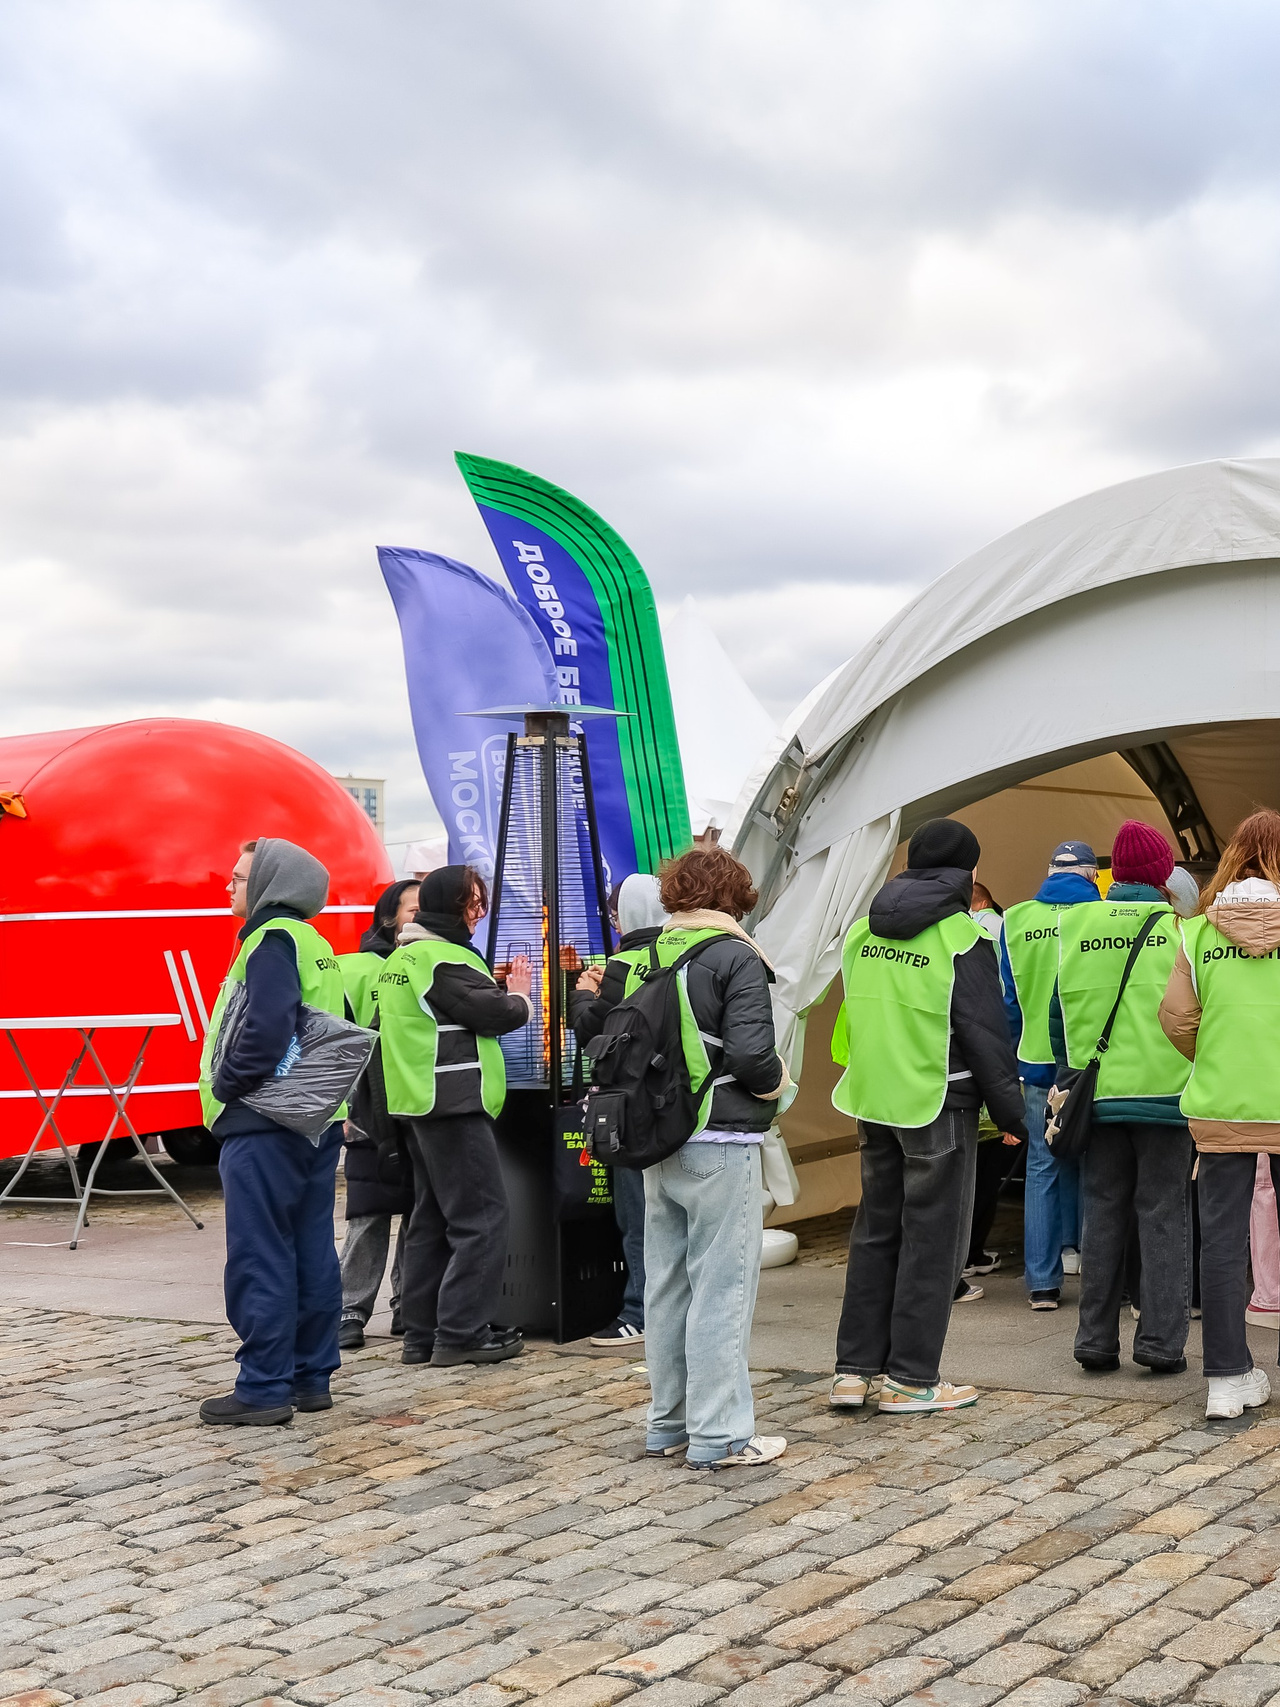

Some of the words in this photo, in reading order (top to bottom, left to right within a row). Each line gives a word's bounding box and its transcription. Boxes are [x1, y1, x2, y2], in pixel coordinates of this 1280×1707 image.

[512, 540, 578, 657] ДОБРОЕ
[1025, 926, 1059, 941] ВОЛО
[1080, 935, 1167, 953] ВОЛОНЕР
[861, 945, 930, 968] ВОЛОНТЕР
